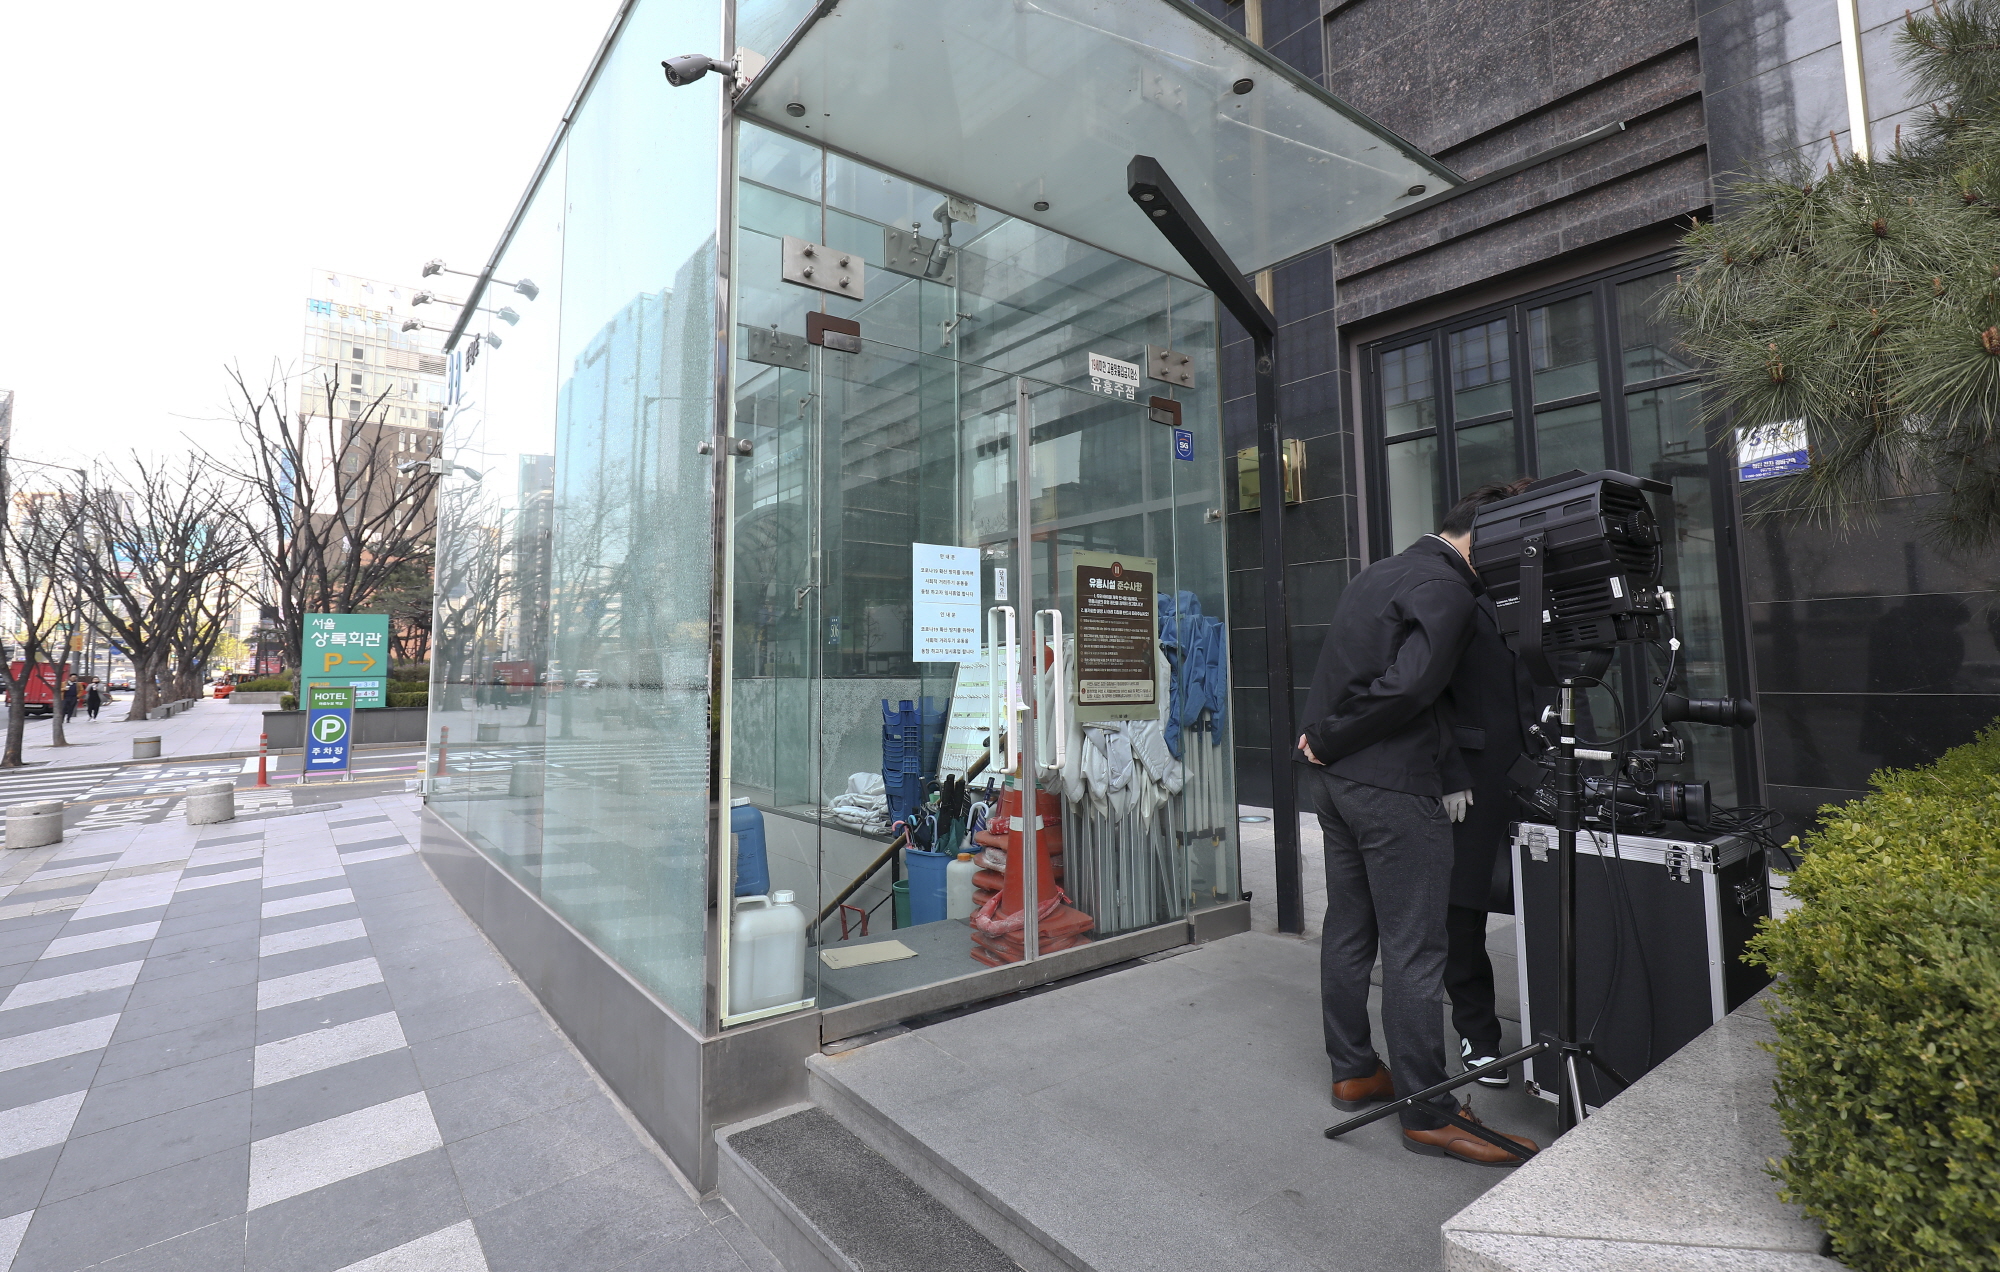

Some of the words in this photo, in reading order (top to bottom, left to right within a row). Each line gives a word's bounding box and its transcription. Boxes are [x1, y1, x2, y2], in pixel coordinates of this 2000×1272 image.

[1091, 377, 1135, 400] 유흥주점
[1089, 577, 1116, 590] 유흥시설
[1117, 580, 1143, 592] 준수사항
[312, 618, 336, 629] 서울
[311, 631, 382, 648] 상록회관
[323, 652, 343, 672] P
[314, 692, 348, 701] HOTEL
[320, 719, 341, 741] P
[311, 746, 344, 756] 주차장
